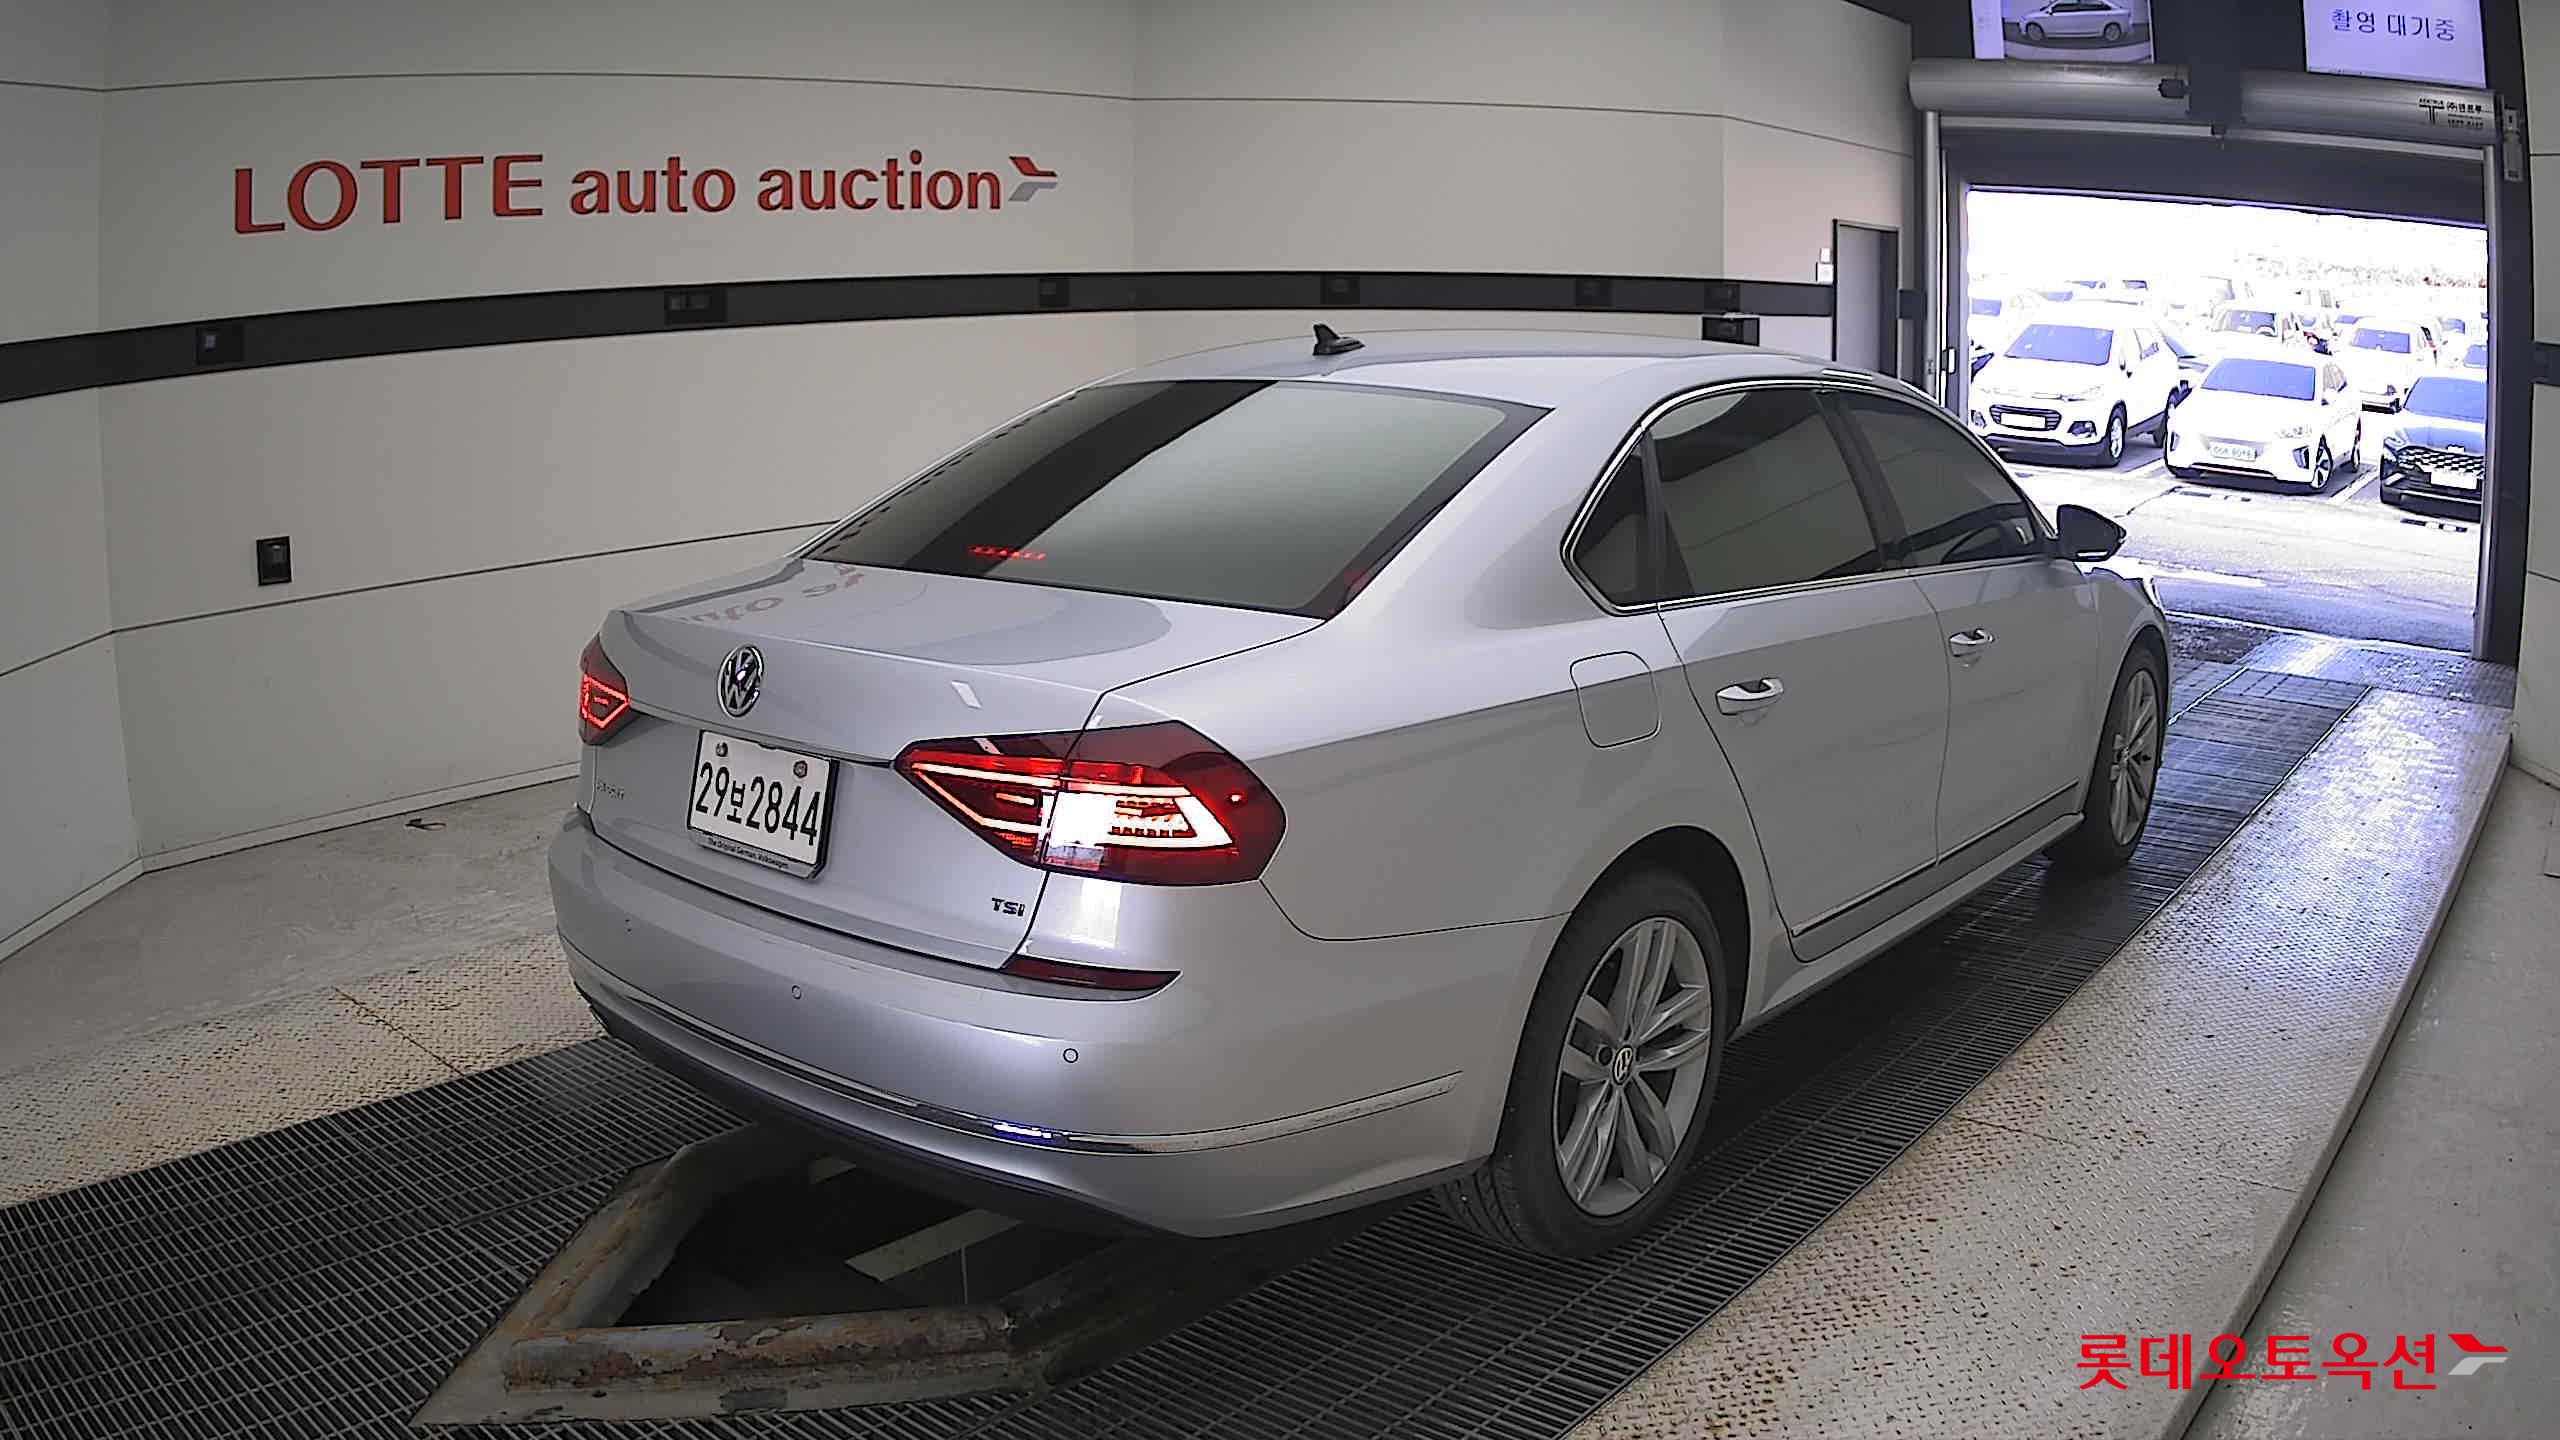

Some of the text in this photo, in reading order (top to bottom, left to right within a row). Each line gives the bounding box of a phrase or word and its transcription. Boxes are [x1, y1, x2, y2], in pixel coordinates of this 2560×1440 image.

[2332, 8, 2456, 42] 촬영 대기중
[234, 149, 1001, 234] LOTTE auto auction
